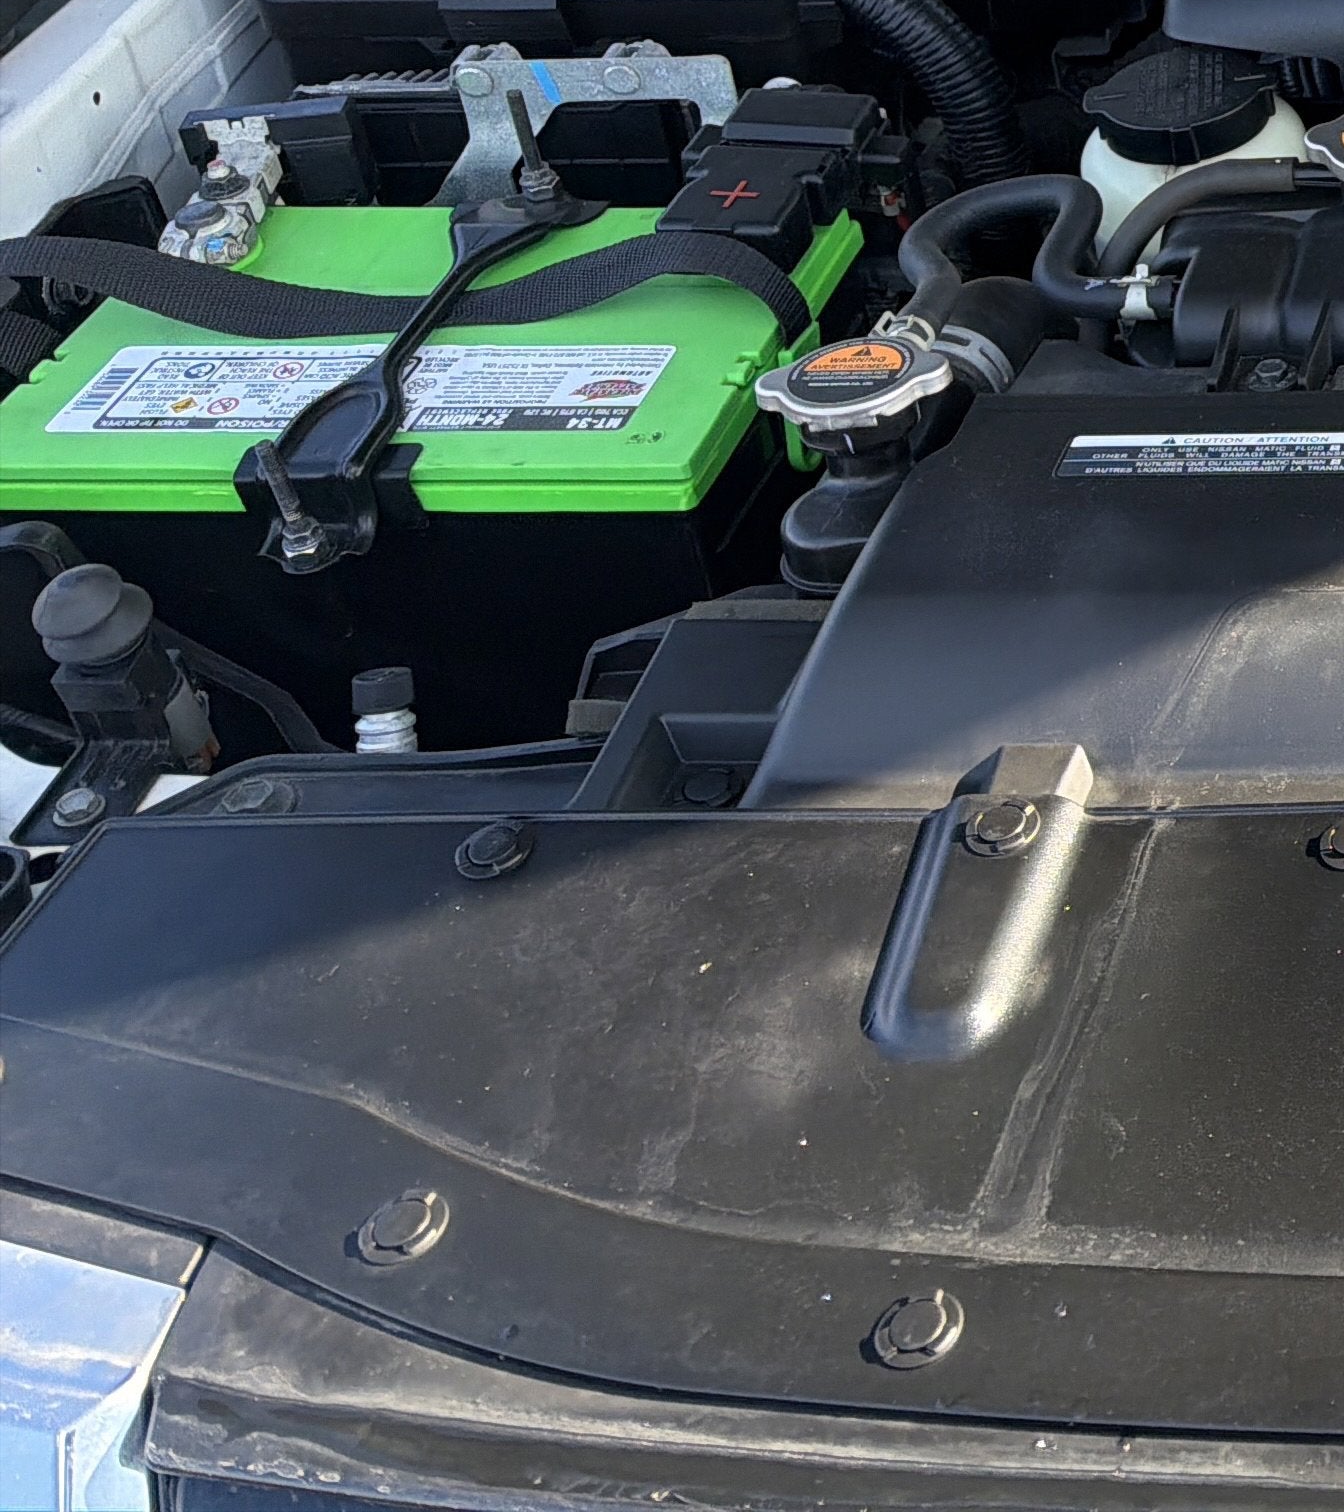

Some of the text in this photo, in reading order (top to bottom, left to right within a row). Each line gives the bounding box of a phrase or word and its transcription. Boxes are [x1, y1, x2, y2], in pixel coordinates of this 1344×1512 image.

[829, 356, 888, 364] WARNING
[810, 362, 898, 370] AVERTISSEMENT
[612, 408, 630, 416] CCA
[415, 414, 510, 426] 24-MONTH
[566, 418, 624, 429] MT-34
[1256, 435, 1331, 443] ATTENTION
